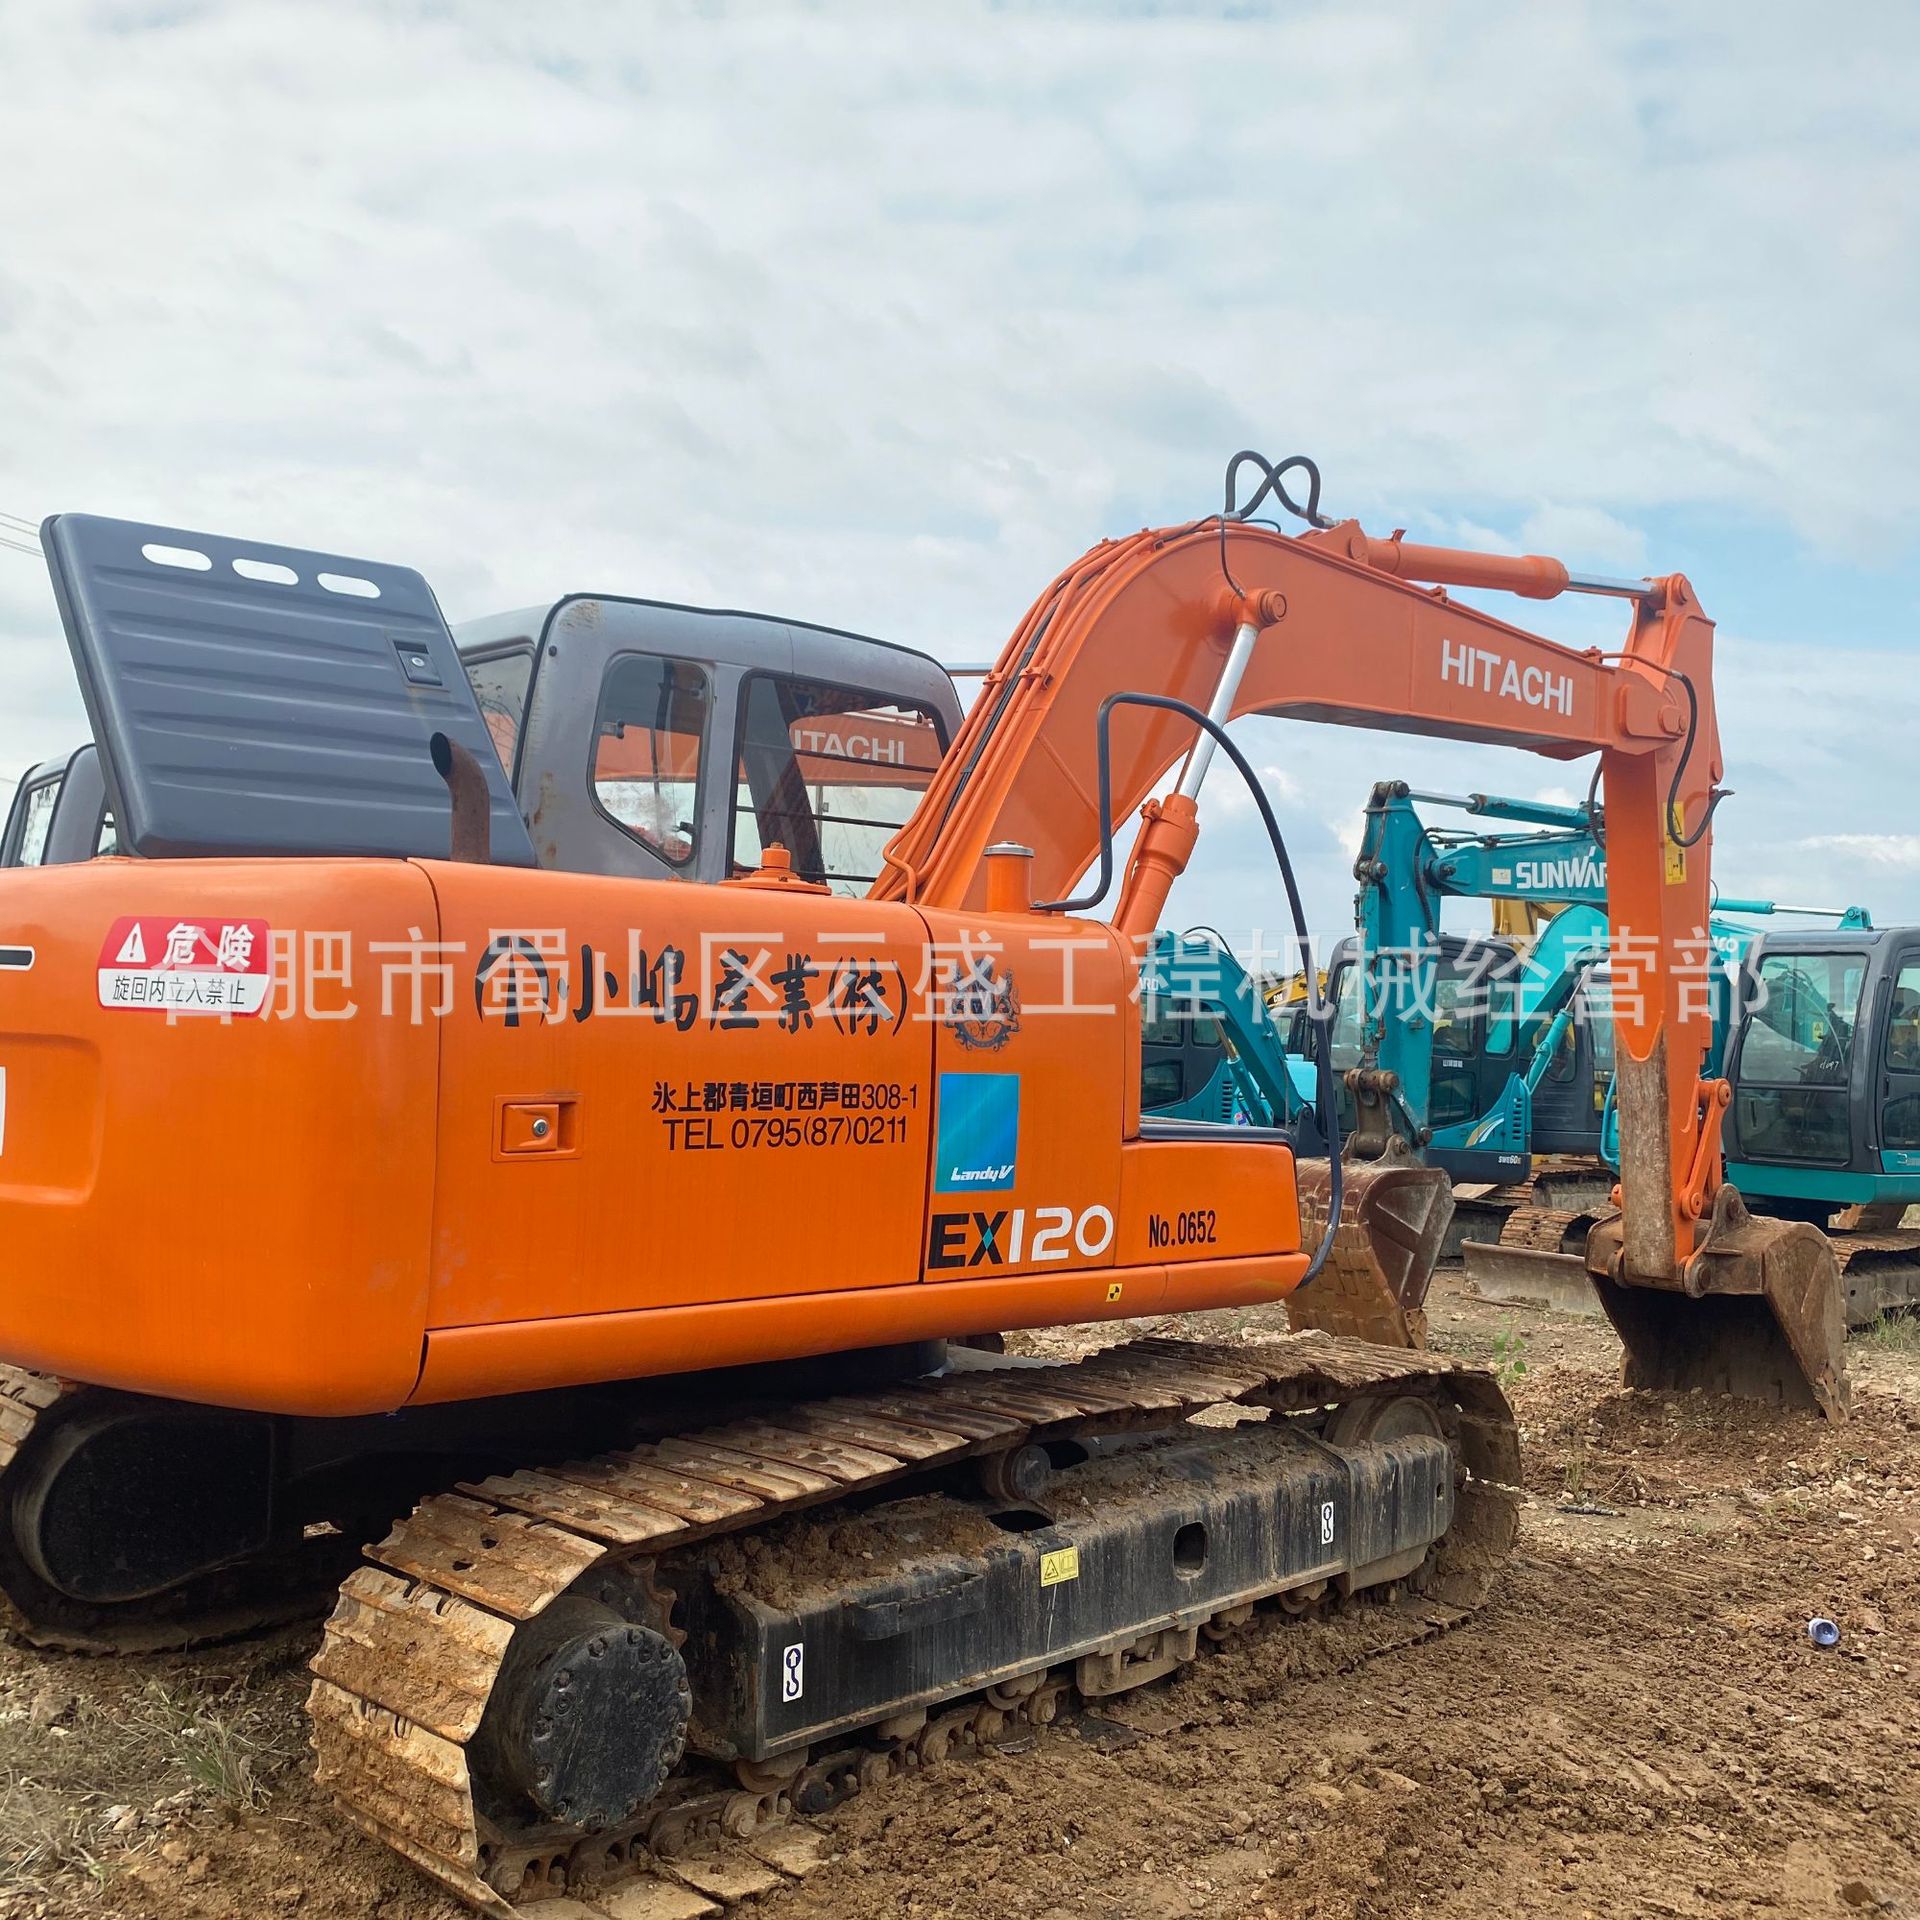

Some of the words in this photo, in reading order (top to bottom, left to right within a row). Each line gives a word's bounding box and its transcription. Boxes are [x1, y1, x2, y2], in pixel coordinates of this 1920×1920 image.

[1441, 639, 1573, 716] HITACHI
[163, 922, 255, 967] 危険
[113, 975, 245, 1005] 旋回内立入禁止
[662, 1117, 724, 1151] TEL
[731, 1115, 907, 1149] 0795(87)0211
[927, 1204, 1114, 1269] EX120
[1148, 1210, 1217, 1248] No.0652
